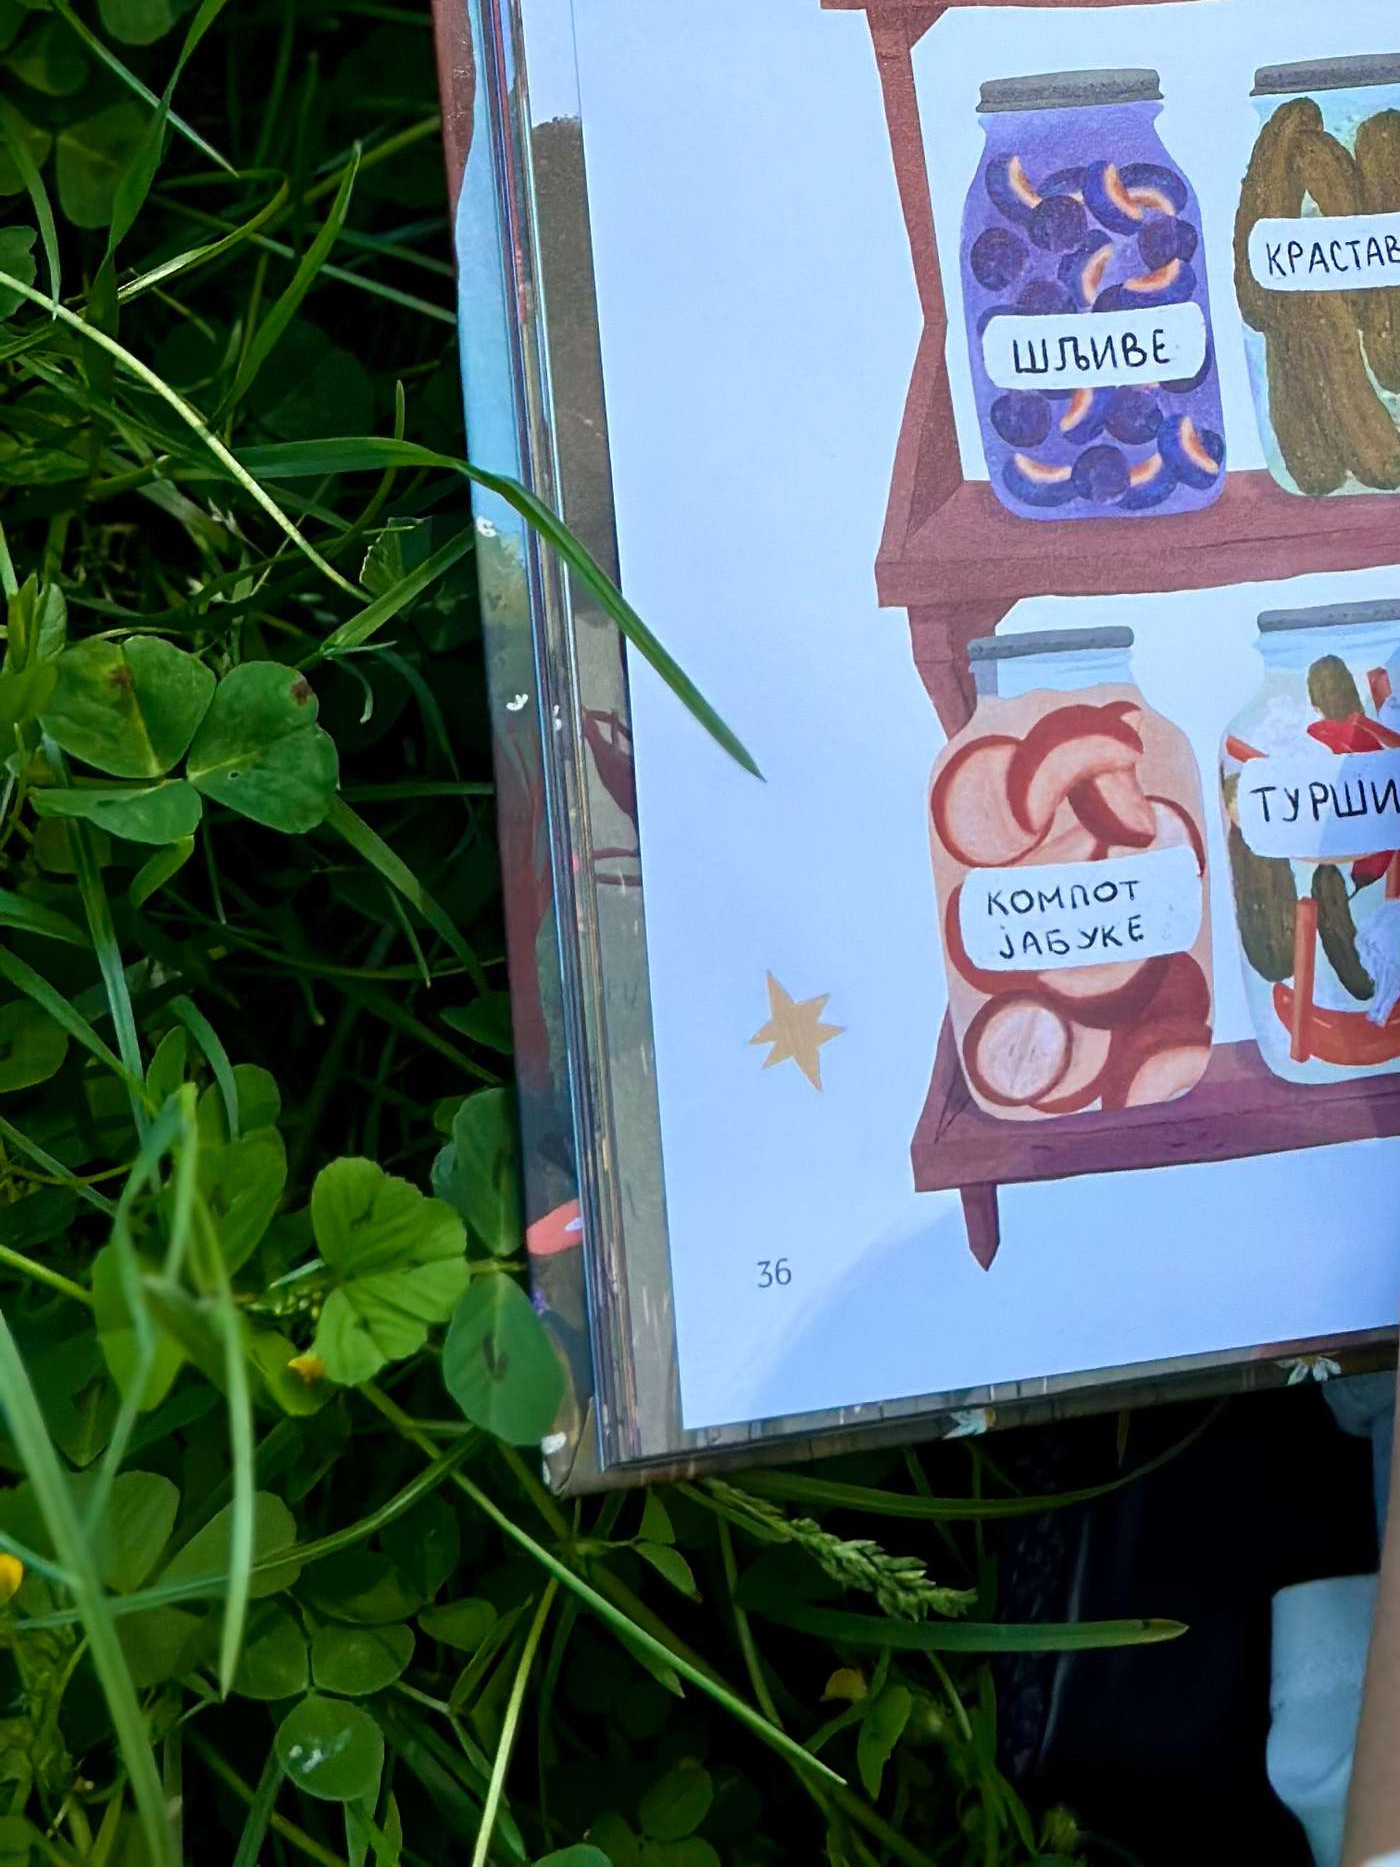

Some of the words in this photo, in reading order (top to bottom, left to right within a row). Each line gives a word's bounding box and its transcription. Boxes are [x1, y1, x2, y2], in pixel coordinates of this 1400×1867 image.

[1013, 329, 1170, 373] ШЉИВЕ
[1251, 779, 1400, 822] ТУРШИ
[988, 881, 1141, 918] КОМПОТ
[1000, 915, 1144, 959] ЈАБУКЕ
[758, 1258, 791, 1288] 36
